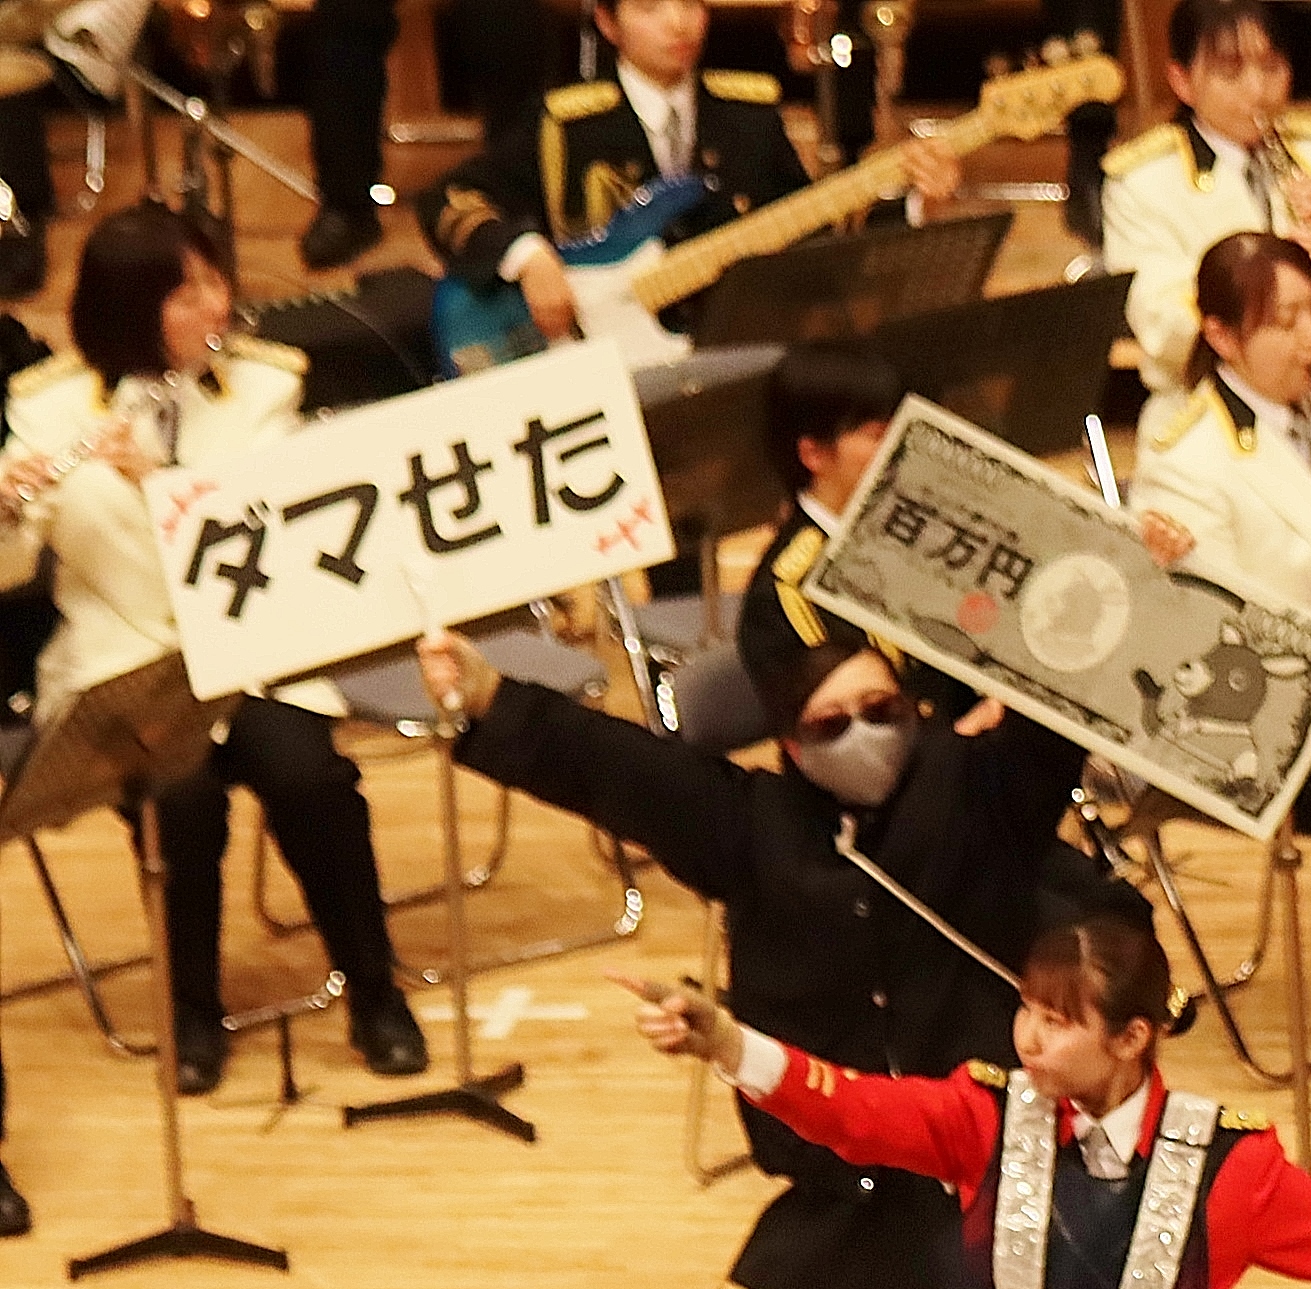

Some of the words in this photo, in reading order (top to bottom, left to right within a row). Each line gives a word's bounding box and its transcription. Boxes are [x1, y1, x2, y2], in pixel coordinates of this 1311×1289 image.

[184, 409, 626, 619] ダマせた
[881, 490, 1036, 603] 百万円
